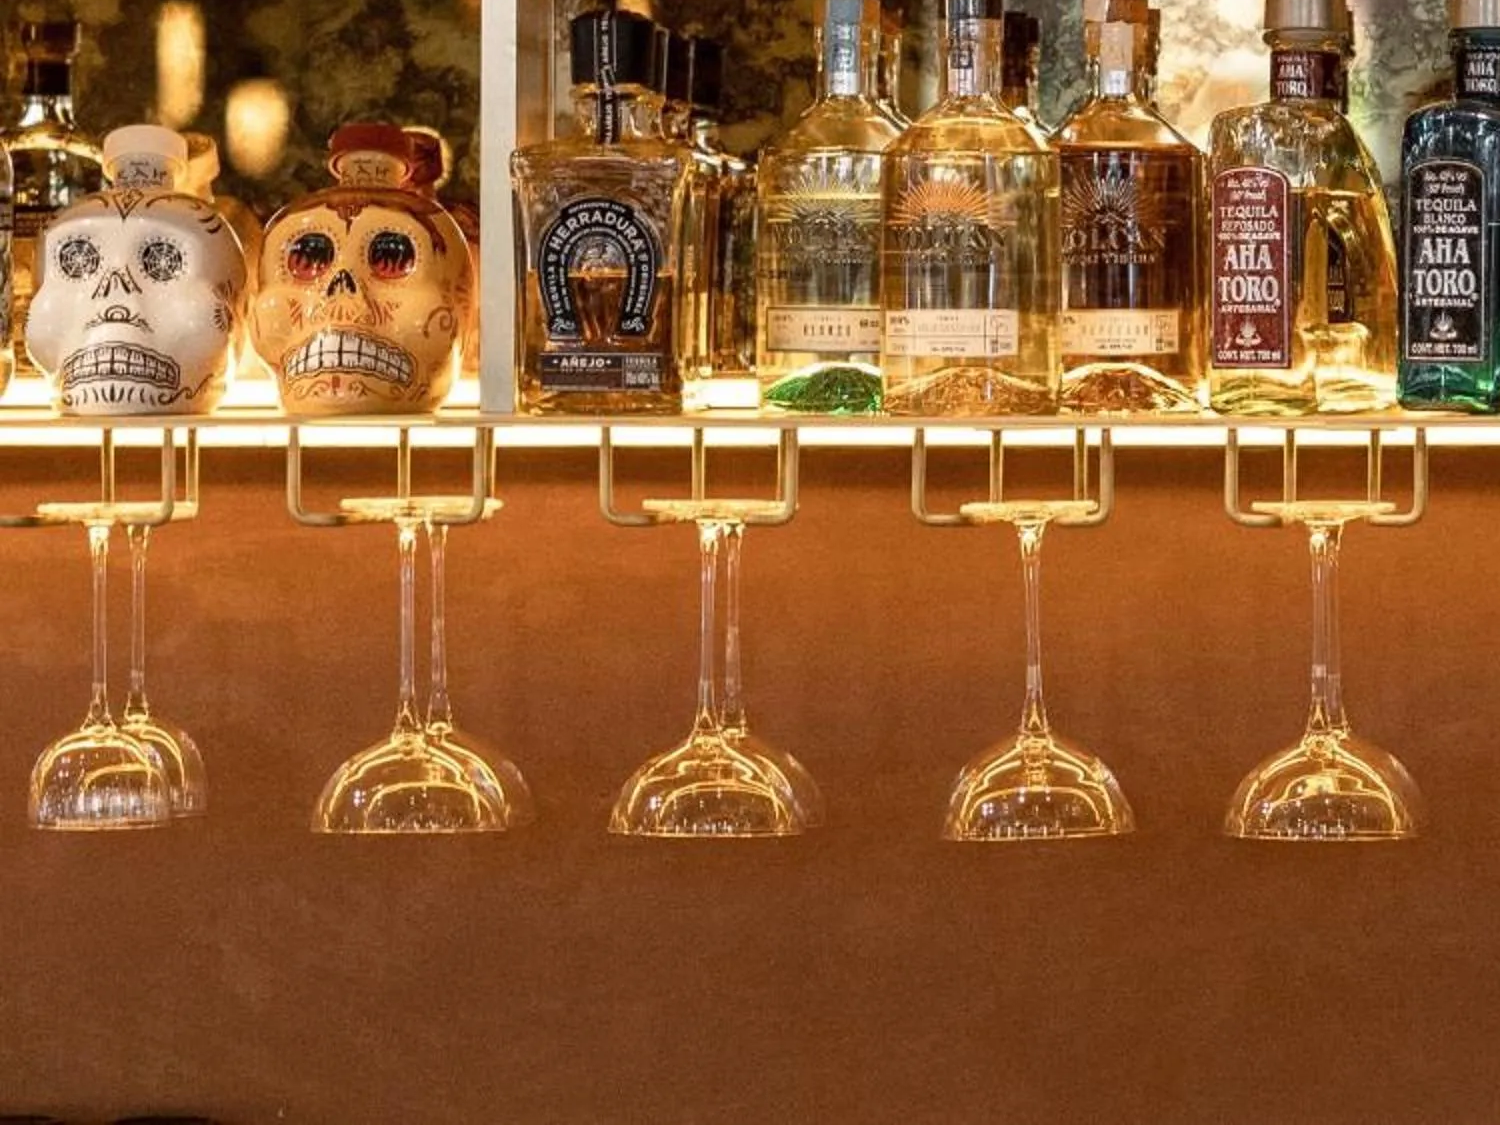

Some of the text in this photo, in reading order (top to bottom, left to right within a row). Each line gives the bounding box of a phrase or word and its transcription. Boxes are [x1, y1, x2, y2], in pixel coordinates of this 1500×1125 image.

[1220, 206, 1279, 218] TEQUILA
[1415, 198, 1477, 212] TEQUILA
[1221, 220, 1275, 232] REPOSADO
[1423, 214, 1467, 225] BLANCO
[549, 209, 645, 251] HERRADURA
[1223, 244, 1274, 271] AHA
[1419, 238, 1471, 264] AHA
[1218, 276, 1279, 302] TORO
[1413, 268, 1476, 295] TORO
[560, 355, 606, 369] AÑEJO
